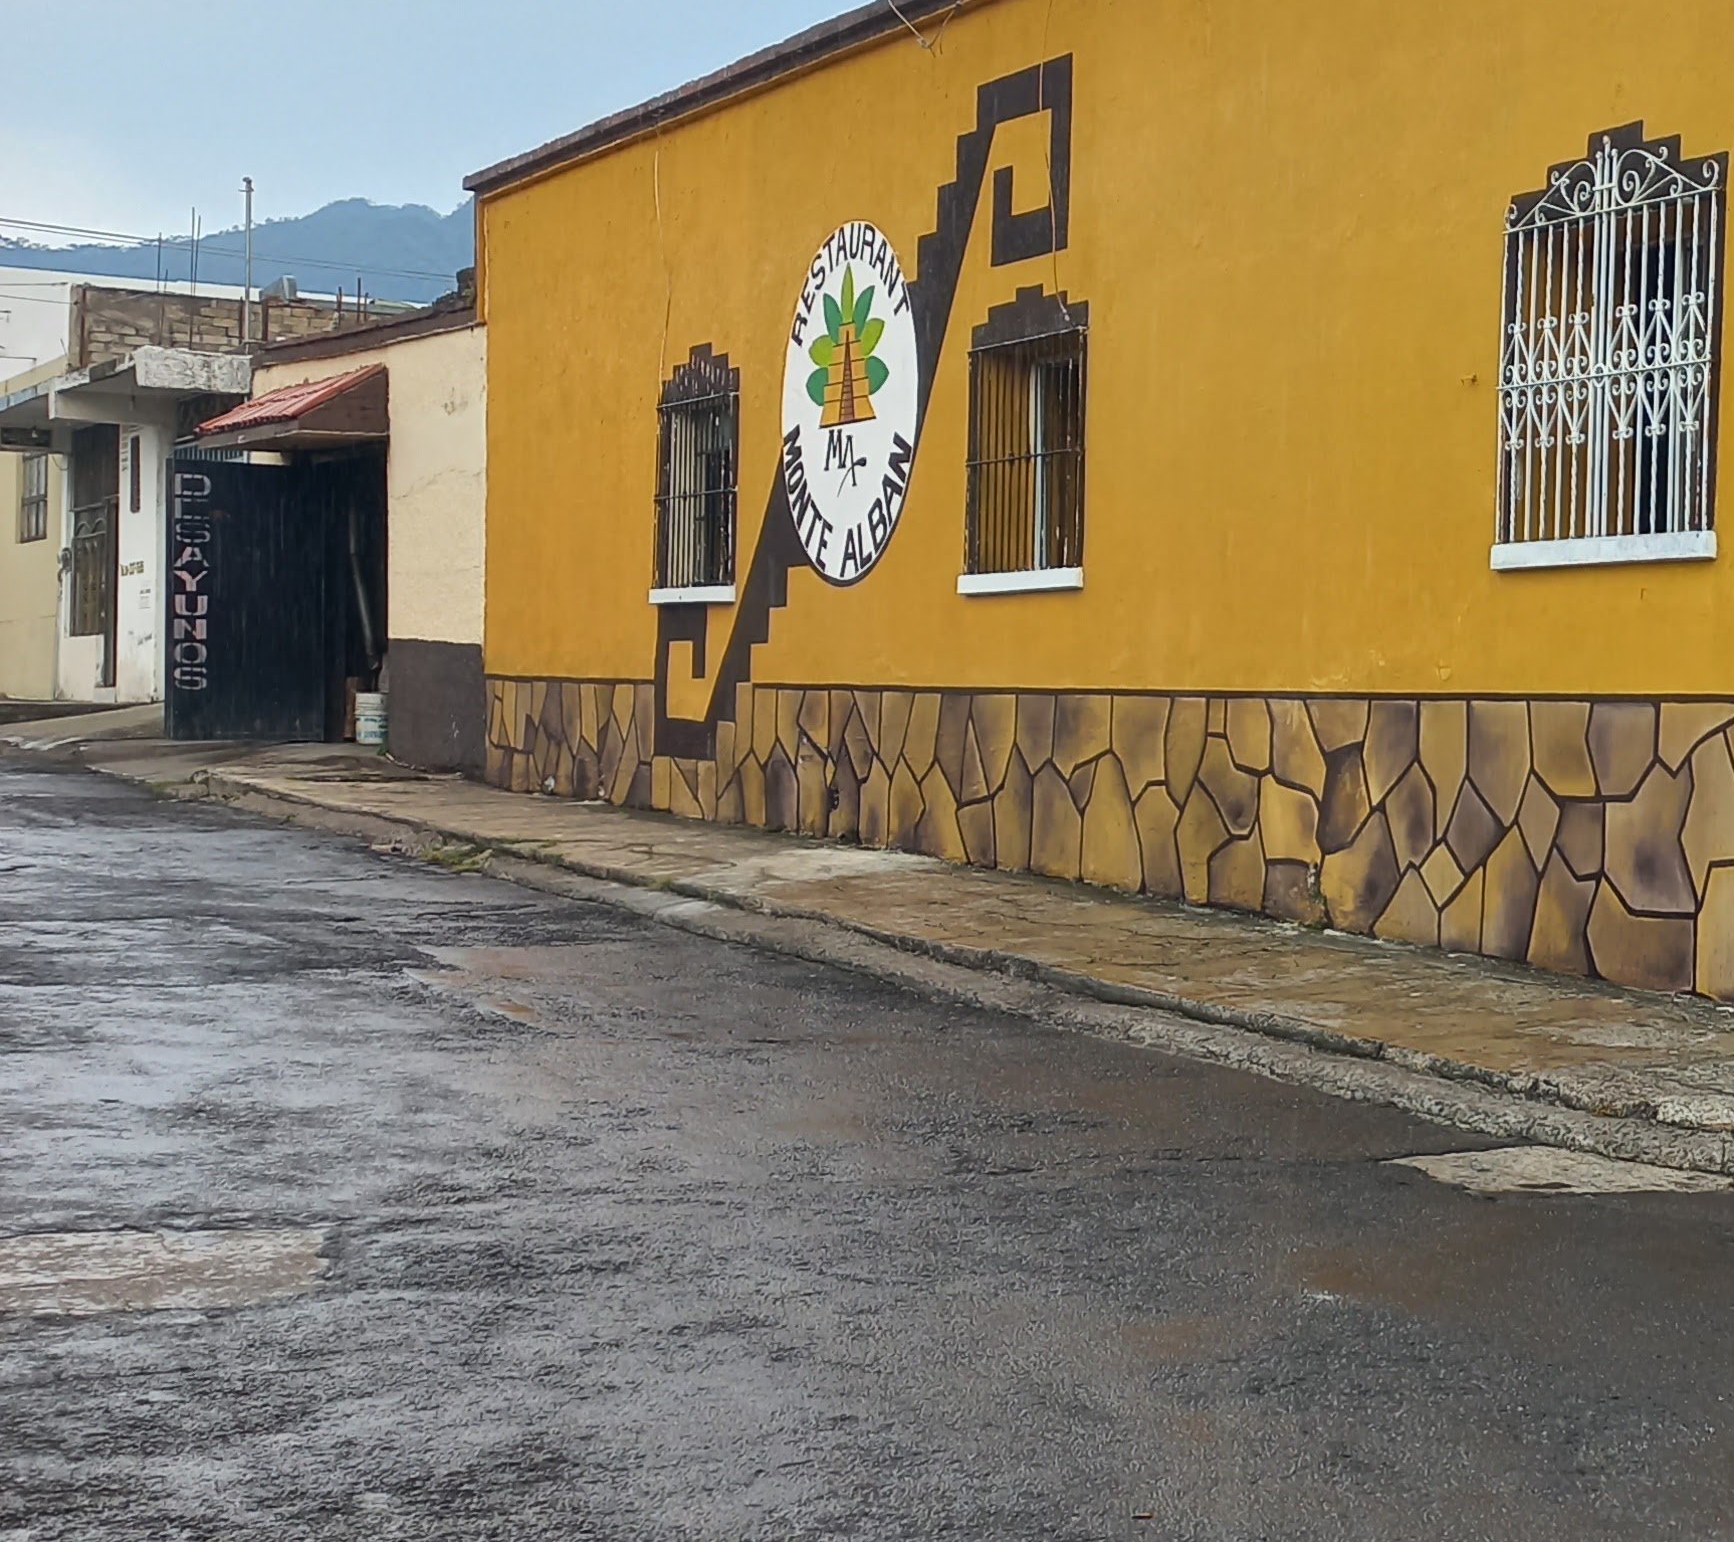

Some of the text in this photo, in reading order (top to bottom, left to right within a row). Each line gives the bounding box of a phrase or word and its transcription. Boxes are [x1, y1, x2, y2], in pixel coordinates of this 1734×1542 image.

[791, 222, 911, 346] RESTAURANT
[783, 424, 912, 579] MONTE ALBAN
[173, 472, 212, 691] DESAYUNOS
